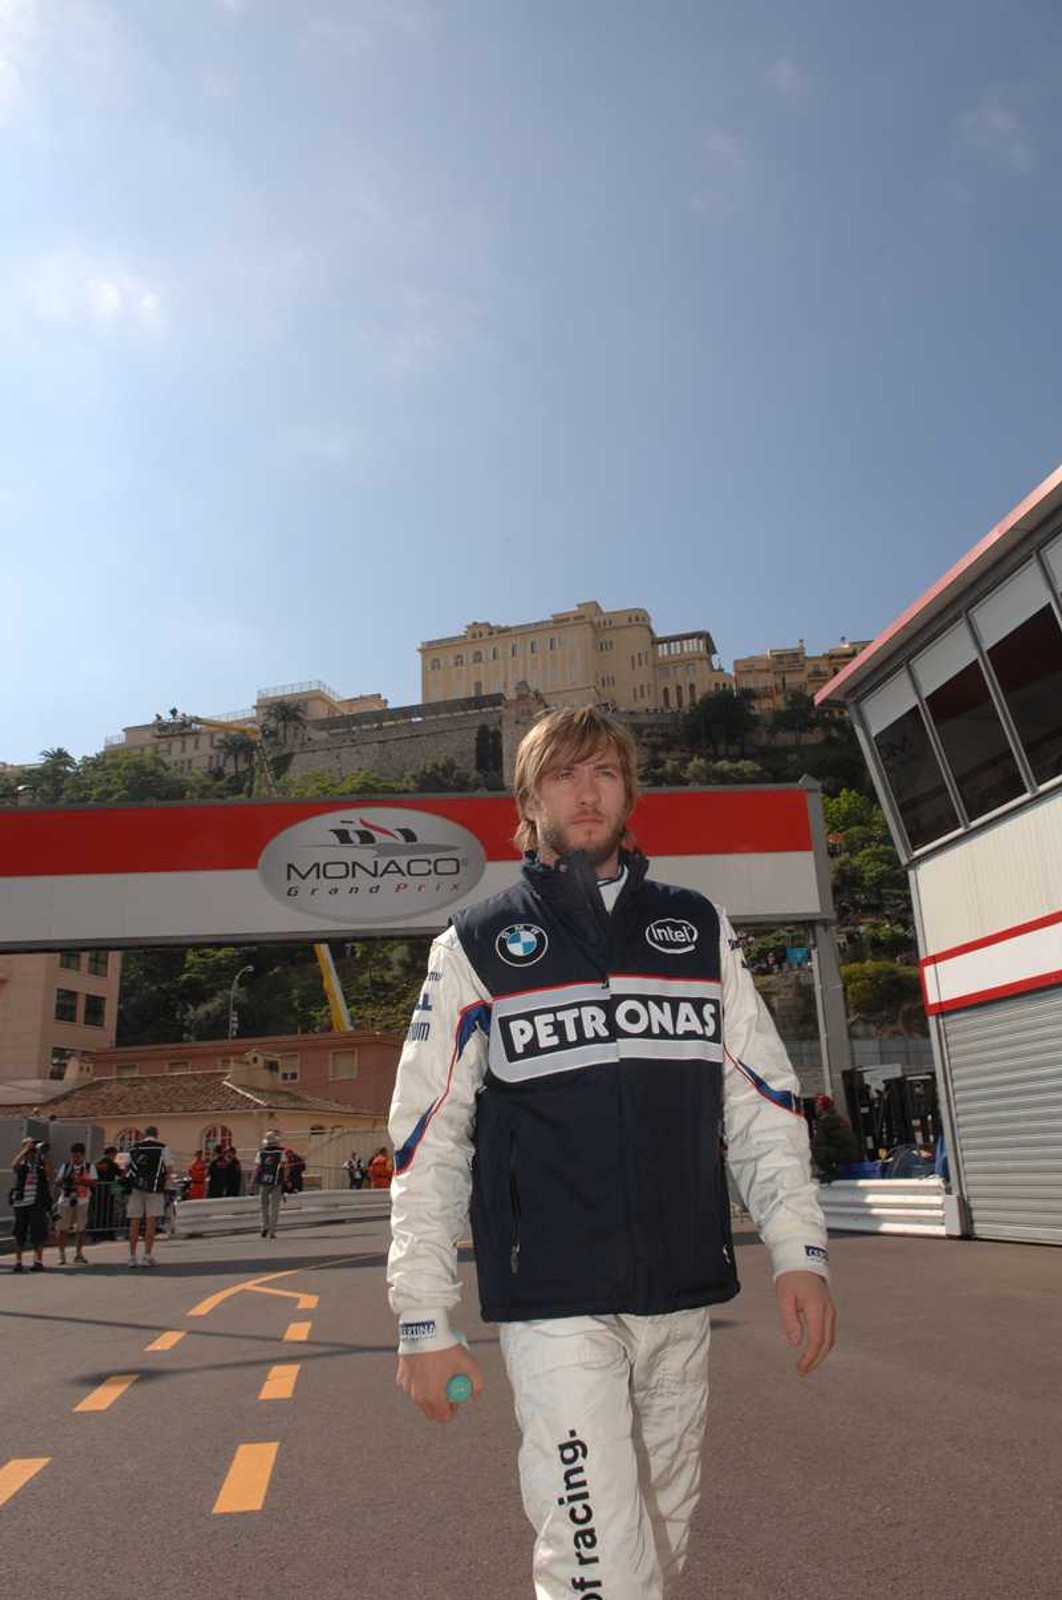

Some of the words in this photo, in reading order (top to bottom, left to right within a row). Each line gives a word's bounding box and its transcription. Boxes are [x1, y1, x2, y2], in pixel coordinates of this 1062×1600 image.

[286, 857, 461, 881] MONACO
[286, 884, 381, 897] Grand
[395, 882, 460, 893] Prix
[558, 1429, 599, 1566] racing.
